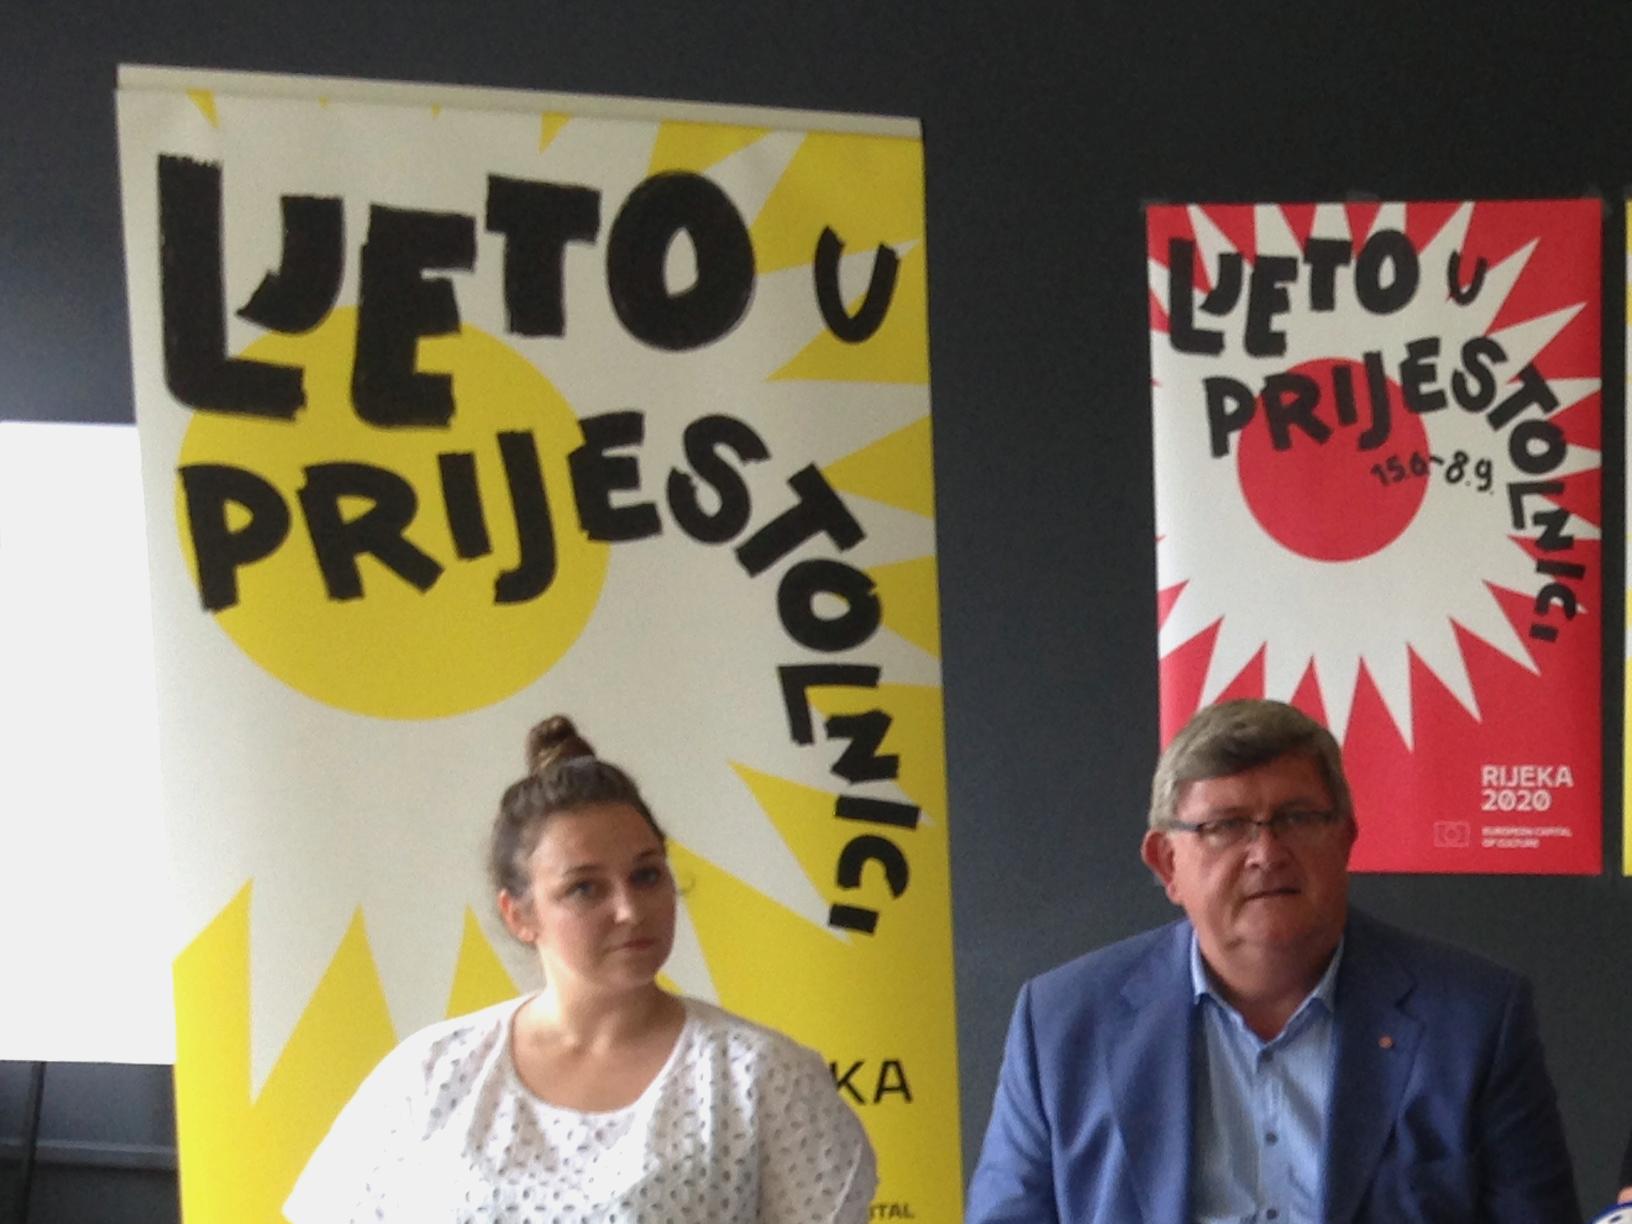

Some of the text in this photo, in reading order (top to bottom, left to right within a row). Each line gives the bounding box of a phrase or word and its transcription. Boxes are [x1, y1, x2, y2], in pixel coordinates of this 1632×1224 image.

[157, 152, 901, 430] LJETO U
[1168, 228, 1489, 358] LJETO U
[1202, 336, 1587, 643] PRIJESTOLNICI
[177, 410, 923, 936] PRIJESTOLNICI
[1480, 789, 1552, 812] 2020
[1481, 764, 1574, 788] RIJEKA
